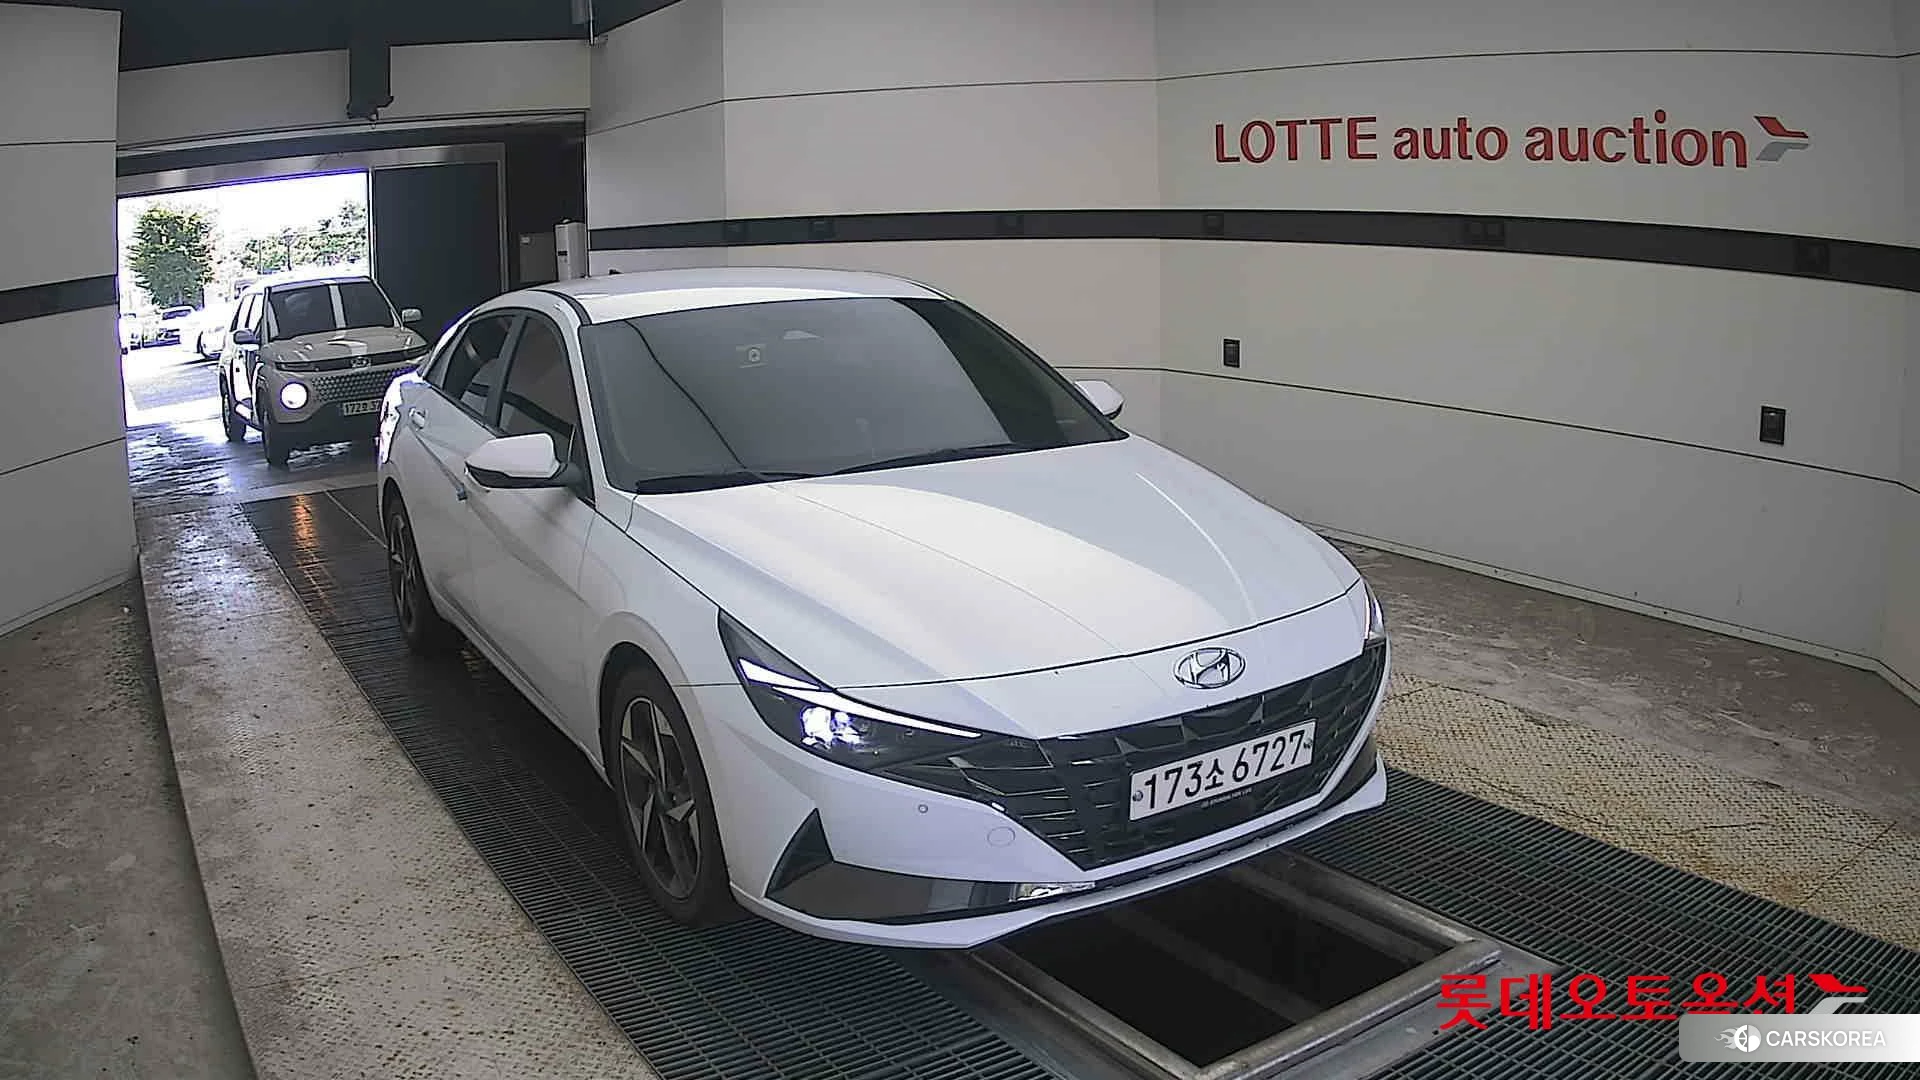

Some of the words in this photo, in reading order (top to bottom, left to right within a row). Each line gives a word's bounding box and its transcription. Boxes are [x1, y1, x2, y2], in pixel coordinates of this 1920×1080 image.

[1215, 116, 1378, 163] LOTTE
[1394, 116, 1509, 161] auto
[1525, 109, 1748, 168] auction
[1232, 729, 1305, 783] 6727
